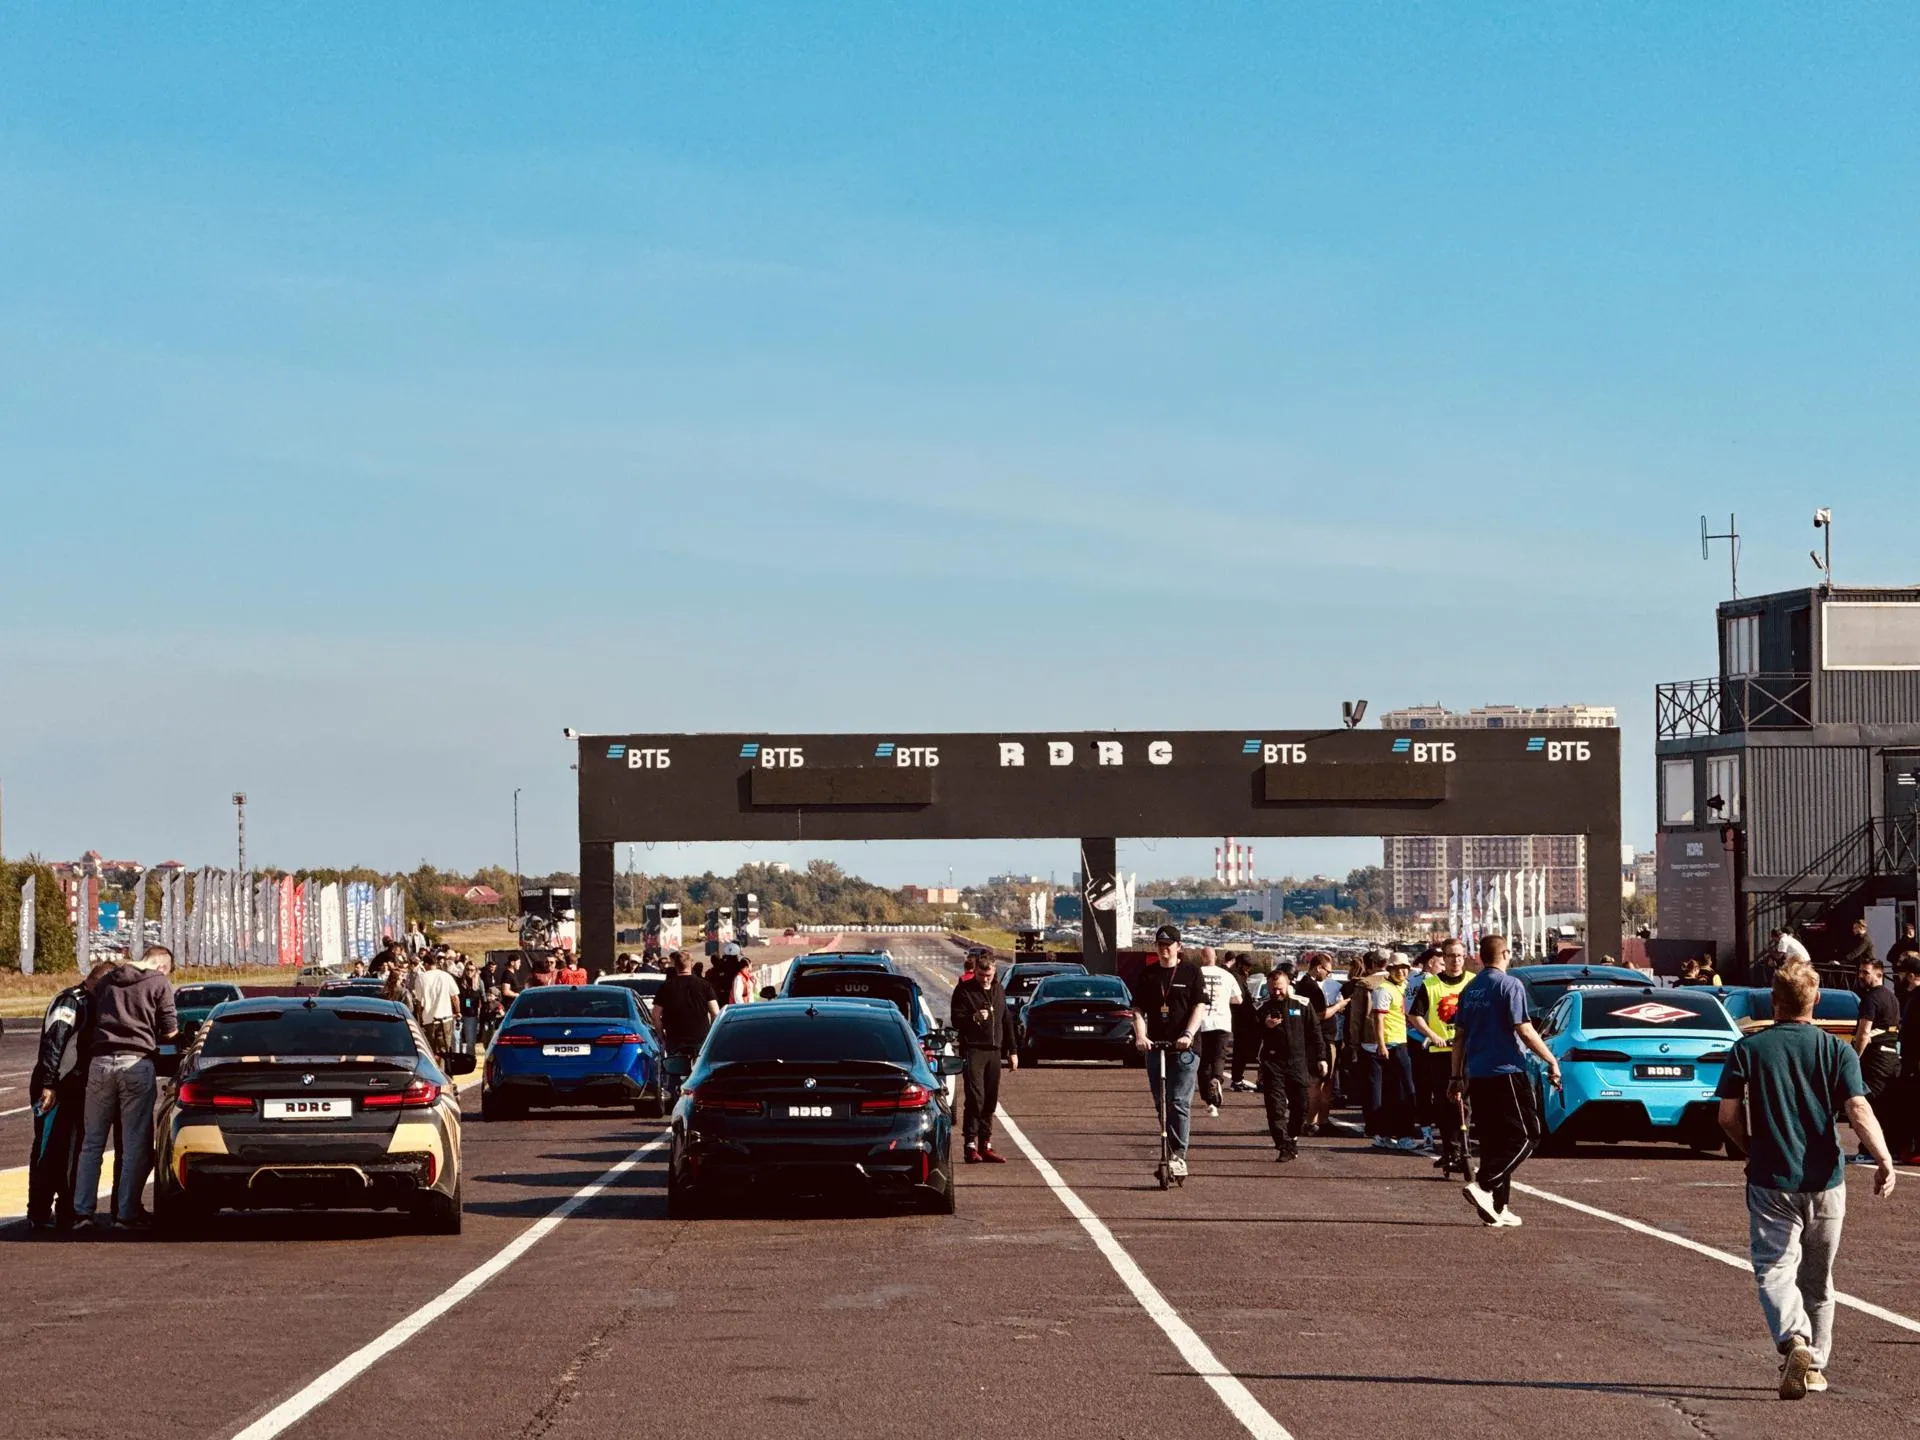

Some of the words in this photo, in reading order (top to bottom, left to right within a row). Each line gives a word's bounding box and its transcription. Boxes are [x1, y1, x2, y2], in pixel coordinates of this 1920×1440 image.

[628, 748, 671, 769] ВТБ
[761, 747, 805, 768] ВТБ
[896, 747, 940, 767] ВТБ
[1263, 743, 1307, 764] ВТБ
[1413, 742, 1457, 762] ВТБ
[1547, 741, 1591, 762] ВТБ
[1647, 1066, 1682, 1076] RDRC
[285, 1102, 332, 1112] RDRC
[788, 1106, 833, 1117] RDRC
